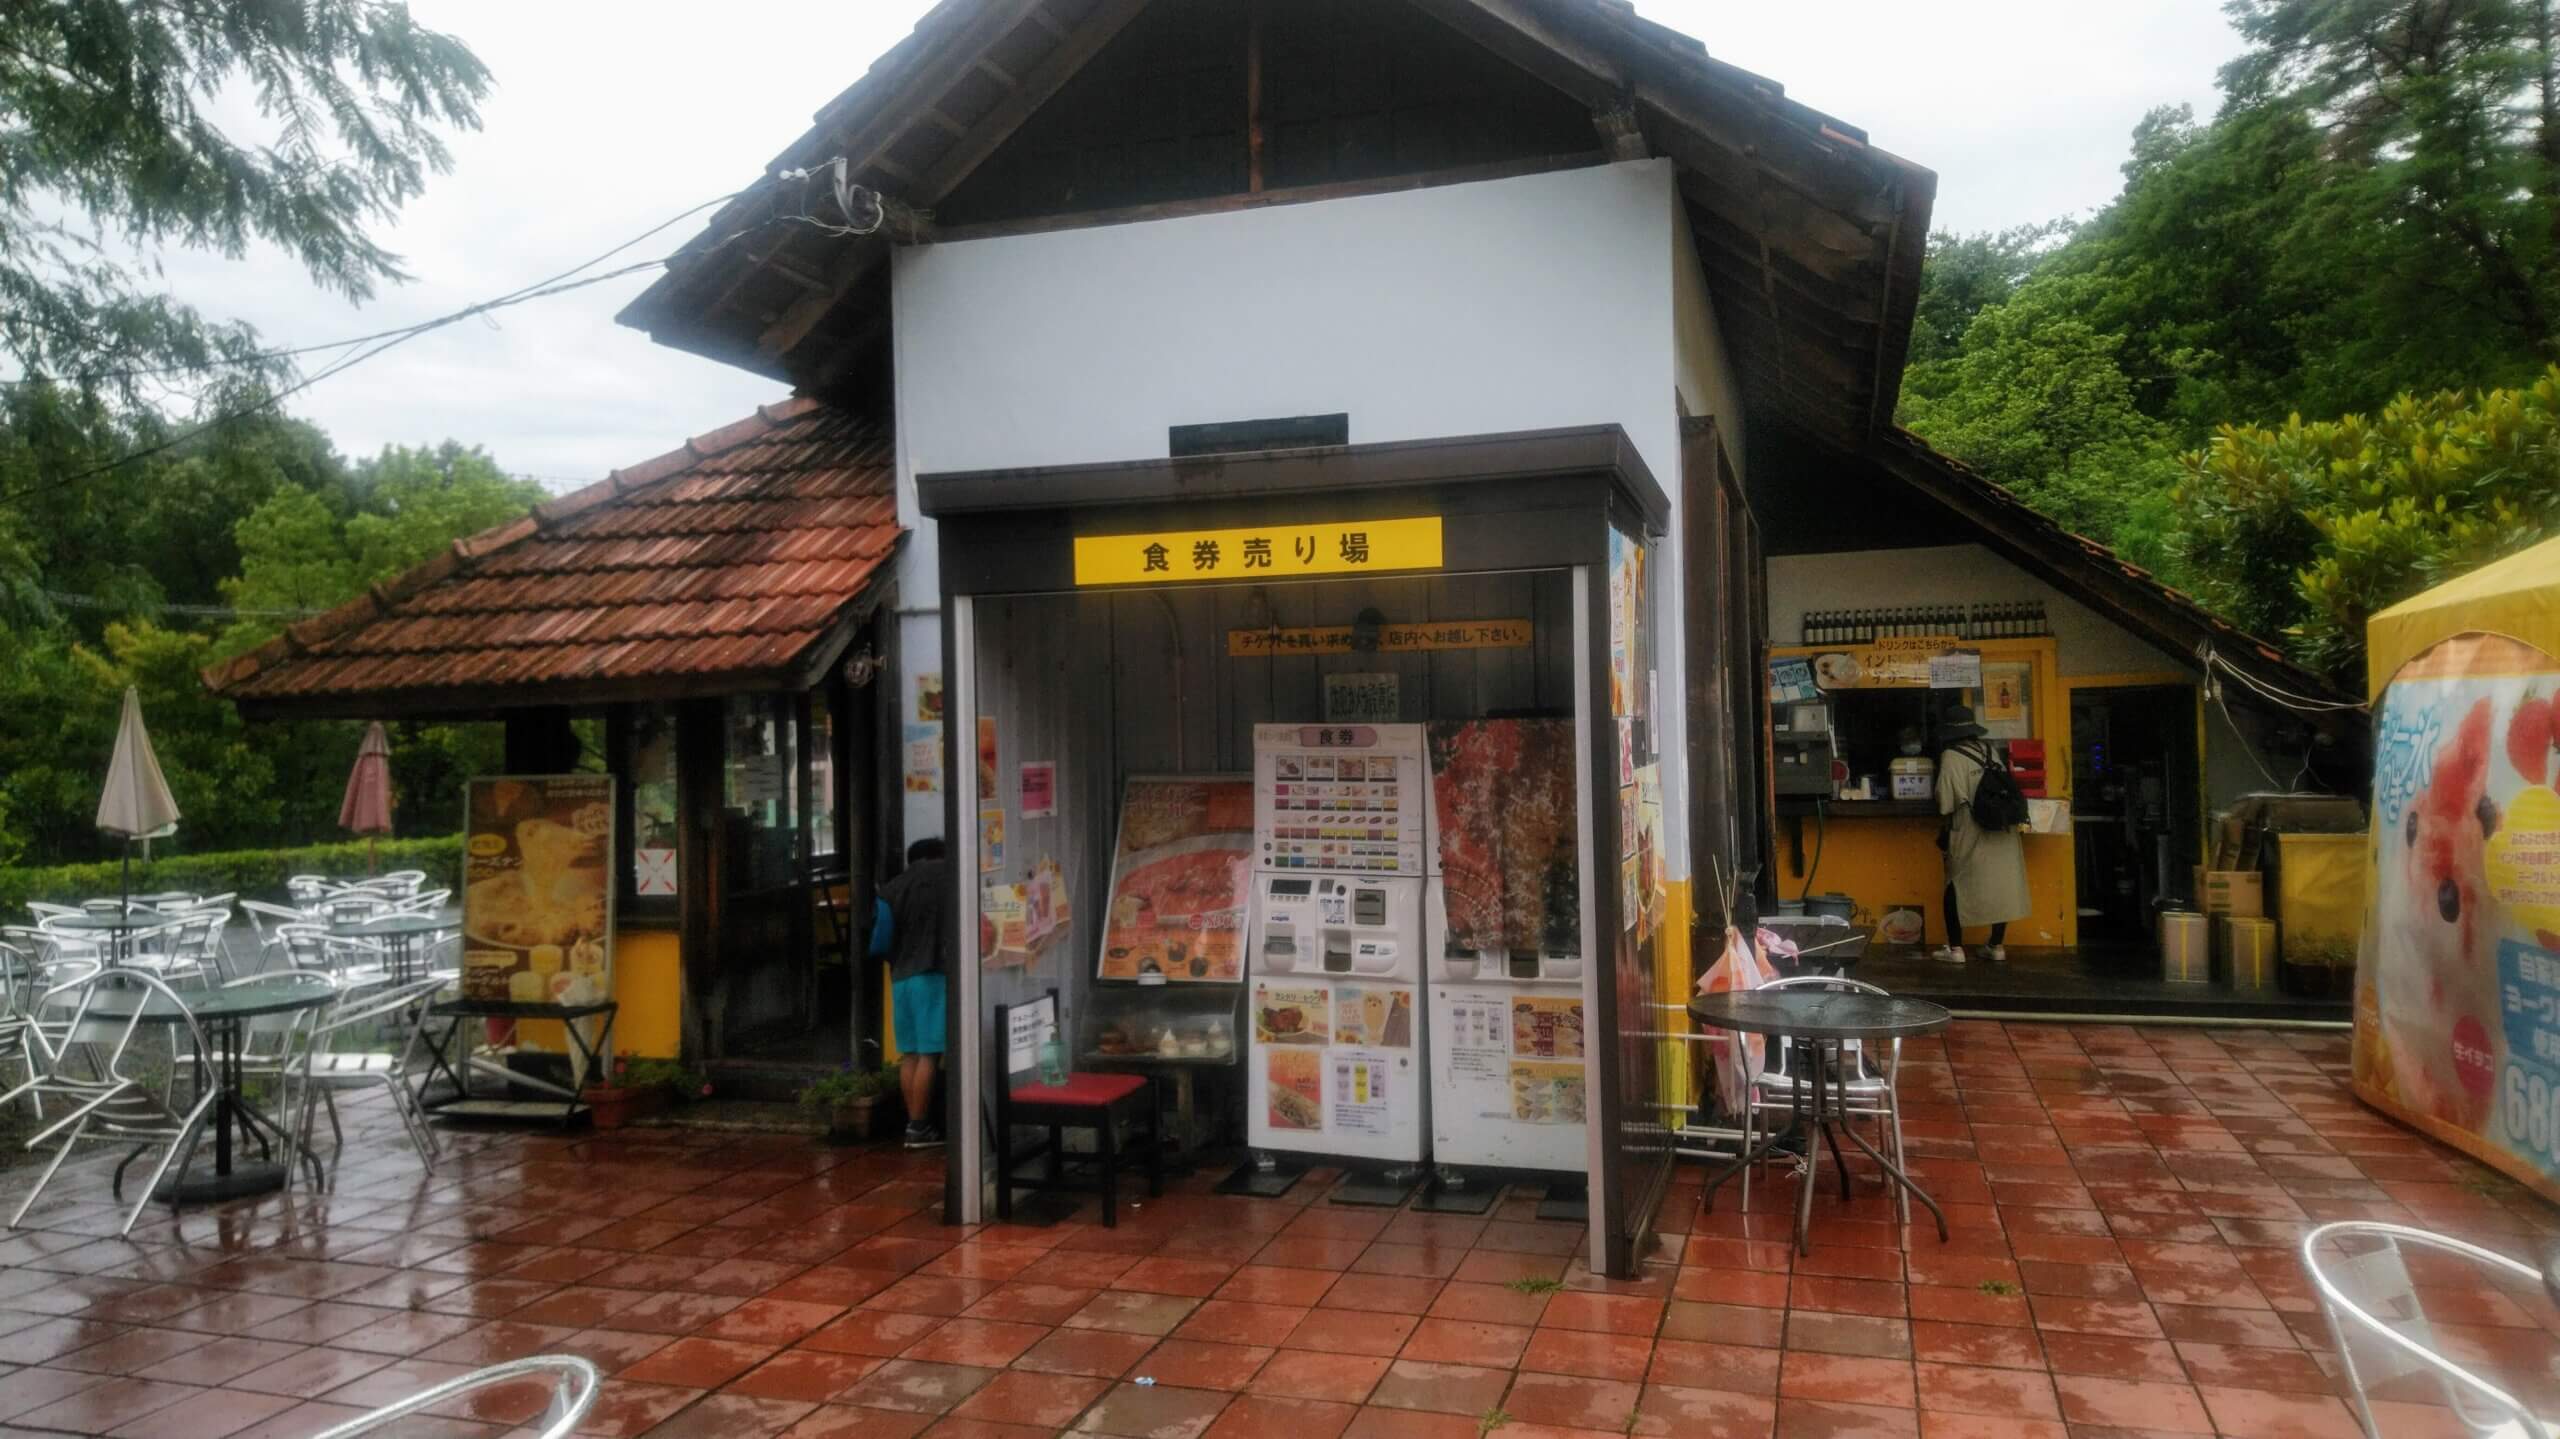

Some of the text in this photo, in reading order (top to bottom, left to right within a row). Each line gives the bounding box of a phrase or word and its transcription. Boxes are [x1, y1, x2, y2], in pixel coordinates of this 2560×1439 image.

[1142, 532, 1370, 572] 食券売り場
[1878, 638, 1957, 651] ドリンクはこちらから
[1319, 728, 1355, 745] 食券
